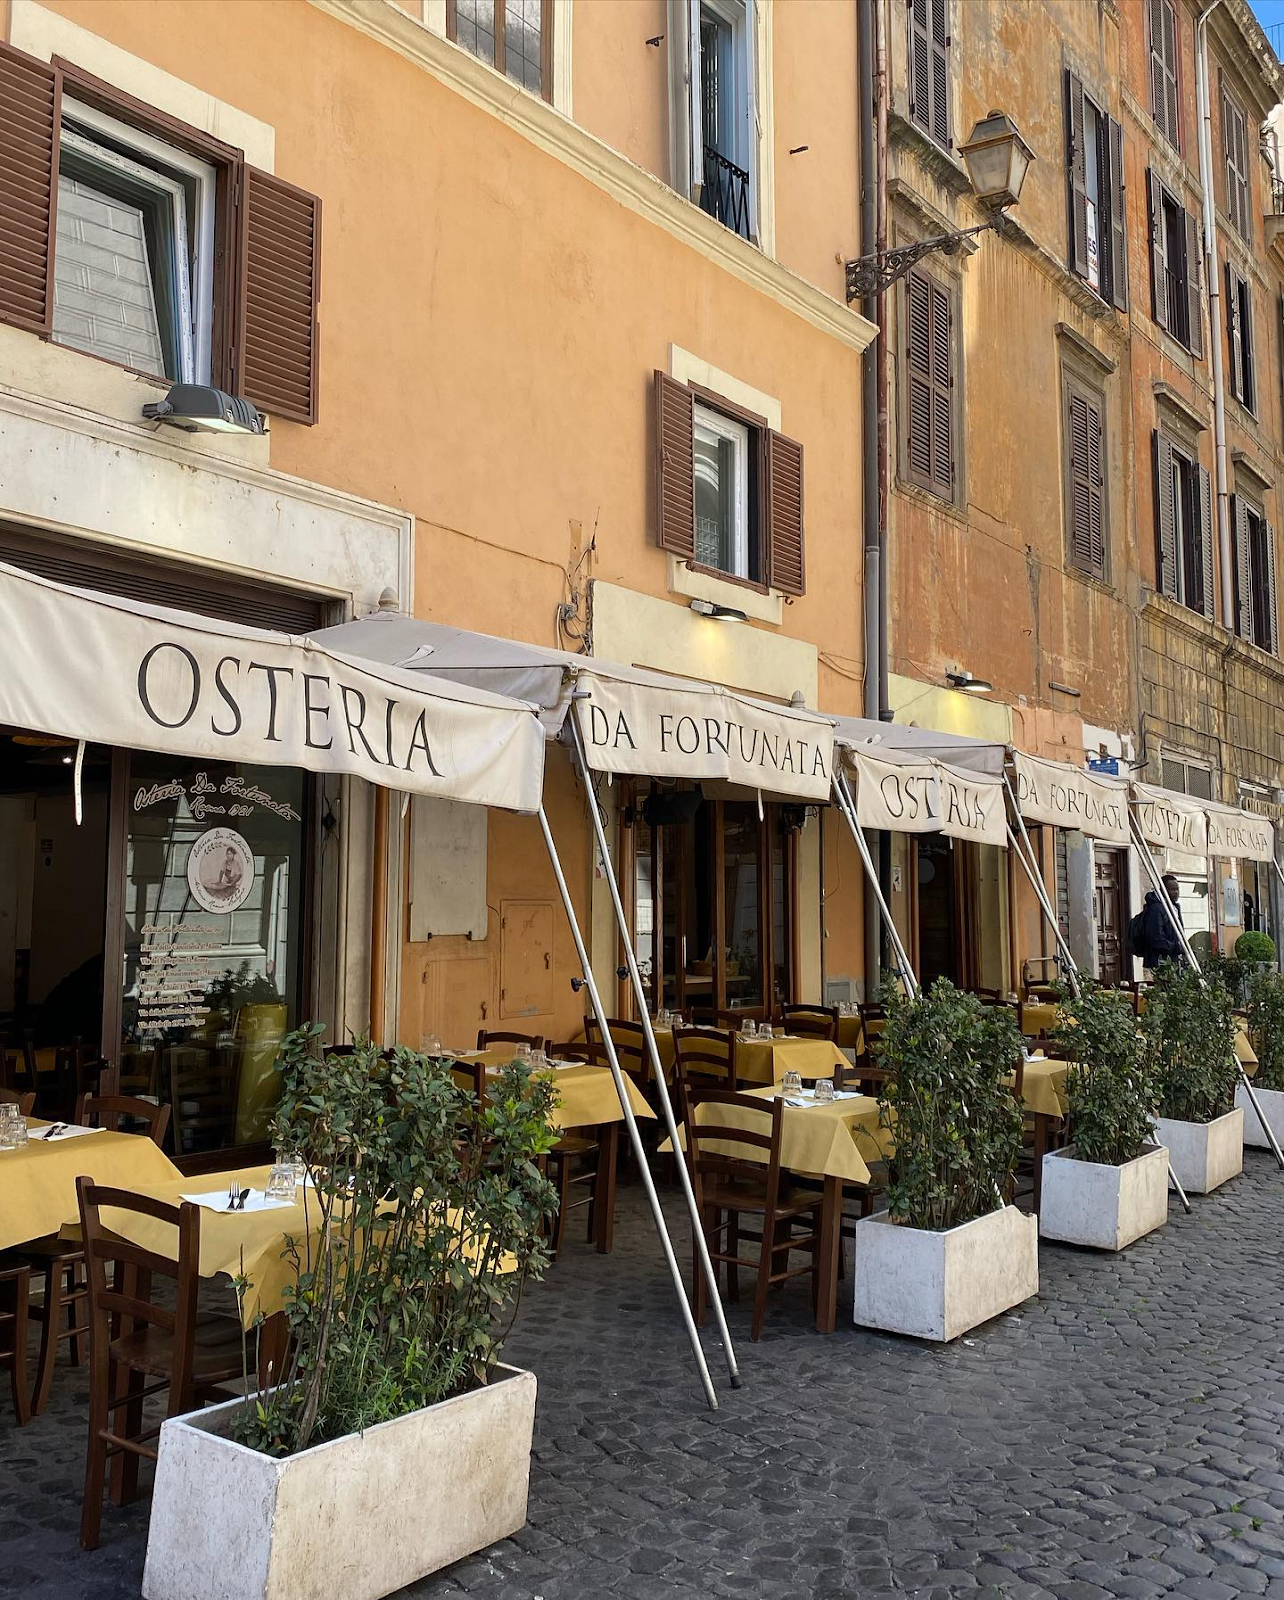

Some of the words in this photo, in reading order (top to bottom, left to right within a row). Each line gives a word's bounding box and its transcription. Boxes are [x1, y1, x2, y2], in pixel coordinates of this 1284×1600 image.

[137, 642, 446, 778] OSTERIA
[589, 704, 638, 750] DA
[658, 714, 828, 779] FORTUNATA
[189, 772, 216, 794] Da
[220, 777, 302, 822] Fortunata
[189, 796, 226, 820] Roma
[880, 774, 986, 831] OSTRIA
[1018, 772, 1040, 806] DA
[1208, 824, 1223, 846] DA
